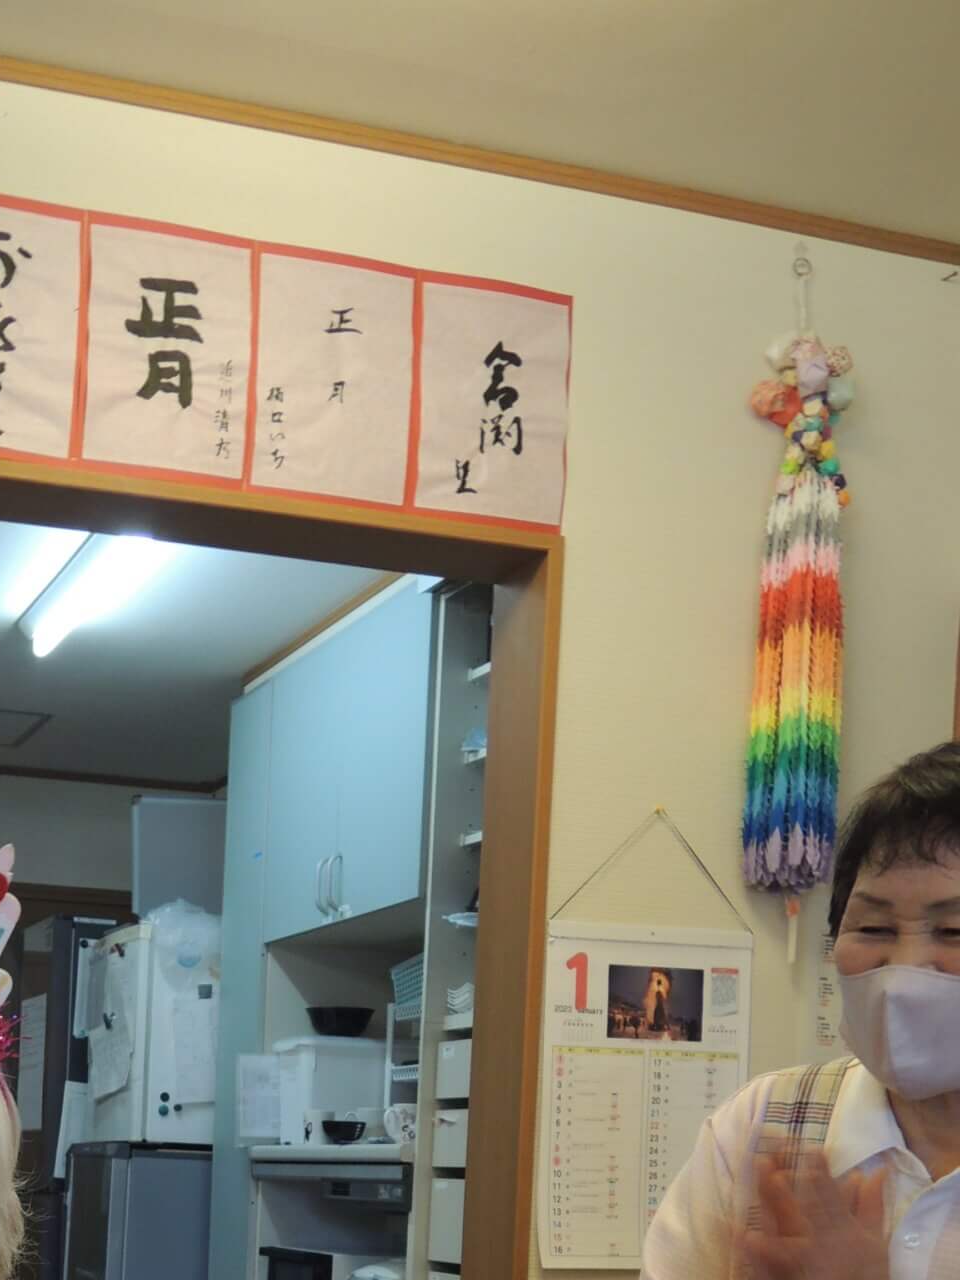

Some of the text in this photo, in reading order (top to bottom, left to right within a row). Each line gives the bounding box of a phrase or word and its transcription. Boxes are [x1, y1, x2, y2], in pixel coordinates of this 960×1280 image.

[125, 277, 204, 410] 正月
[324, 307, 363, 404] 正月
[566, 951, 589, 1010] 1
